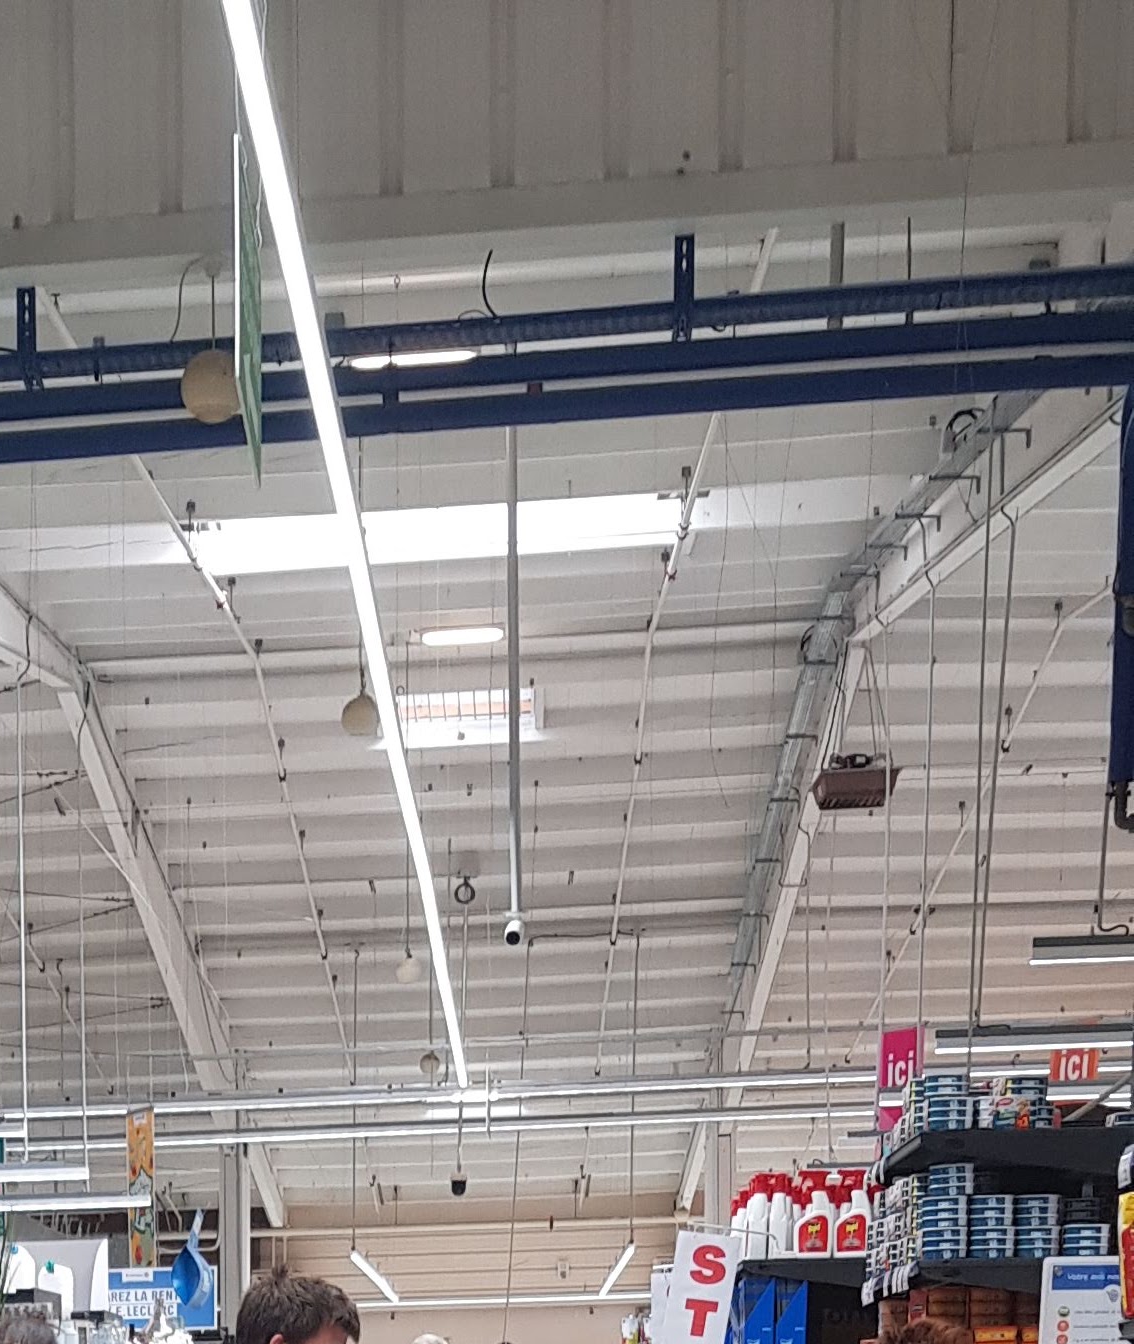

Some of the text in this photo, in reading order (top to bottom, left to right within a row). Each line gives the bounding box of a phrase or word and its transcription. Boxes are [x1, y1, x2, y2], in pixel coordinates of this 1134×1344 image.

[886, 1050, 914, 1087] ici
[1059, 1048, 1089, 1081] ici
[134, 1290, 147, 1301] LA
